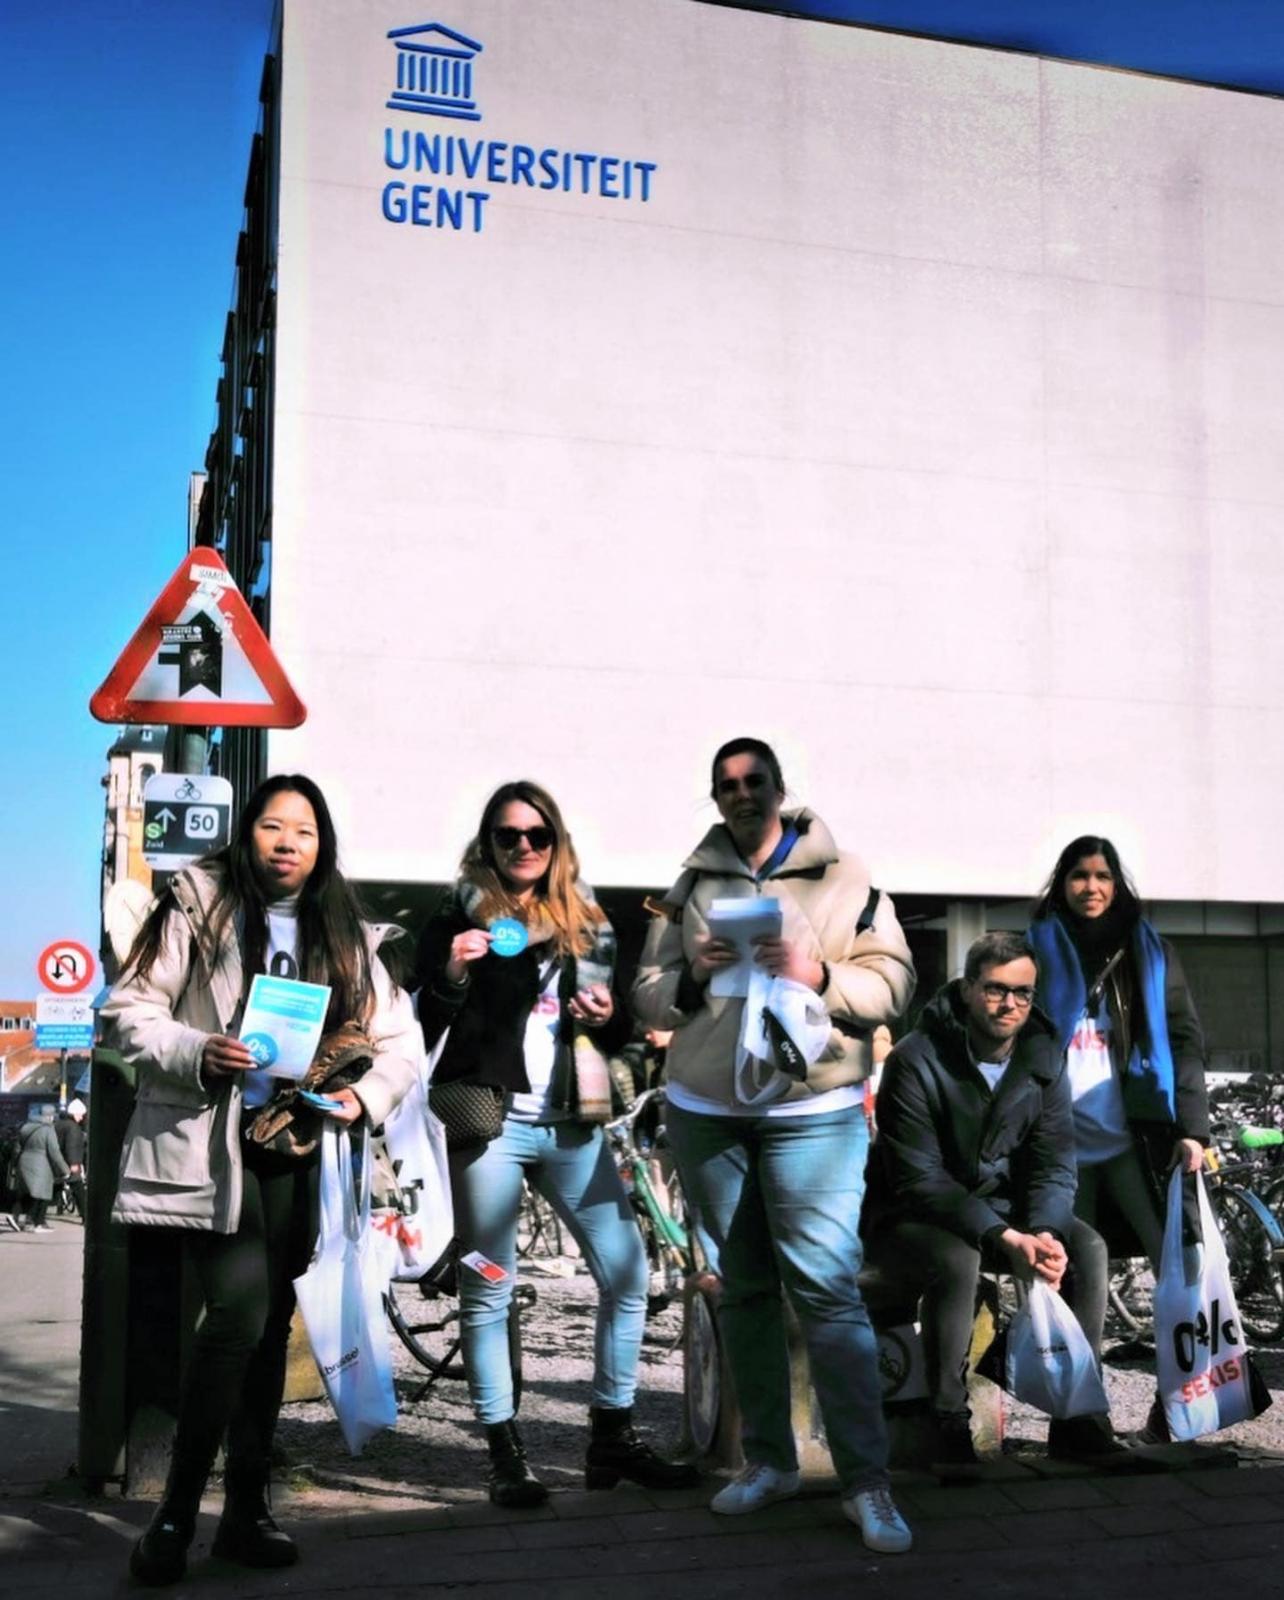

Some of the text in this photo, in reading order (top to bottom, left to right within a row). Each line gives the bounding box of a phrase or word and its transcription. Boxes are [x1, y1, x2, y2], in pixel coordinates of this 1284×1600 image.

[384, 127, 657, 202] UNIVERSITEIT
[382, 181, 490, 232] GENT
[190, 814, 214, 832] 50
[247, 1037, 271, 1061] 0%
